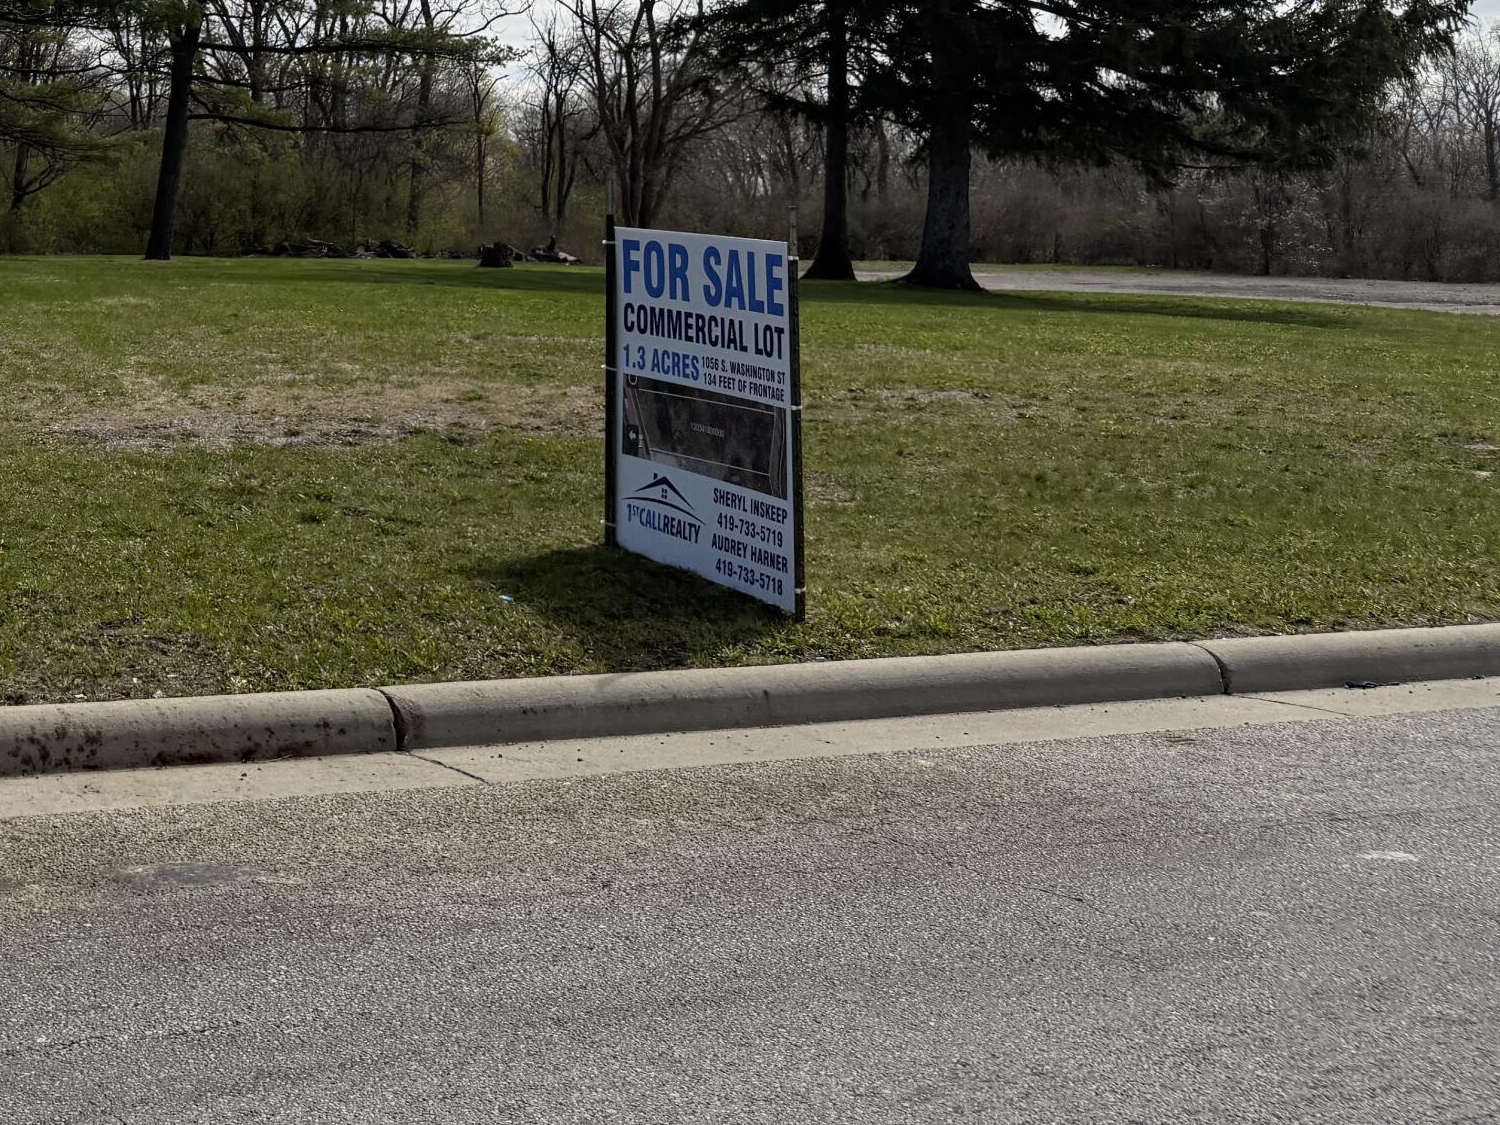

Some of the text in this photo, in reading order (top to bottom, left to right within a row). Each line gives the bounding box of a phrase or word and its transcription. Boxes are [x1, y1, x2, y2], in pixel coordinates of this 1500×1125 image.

[622, 239, 784, 316] FOR SALE
[623, 302, 785, 360] COMMERCIAL LOT
[623, 343, 700, 381] 1.3 ACRES
[702, 355, 786, 386] 1056 S. WASHINGTON ST
[703, 372, 785, 403] 134 FEET OF FRONTAGE
[713, 487, 788, 525] SHERYL INSKEEP
[717, 512, 783, 548] 419-733-5719
[711, 533, 788, 574] AUDREY HARNER
[715, 558, 783, 596] 419-733-5718
